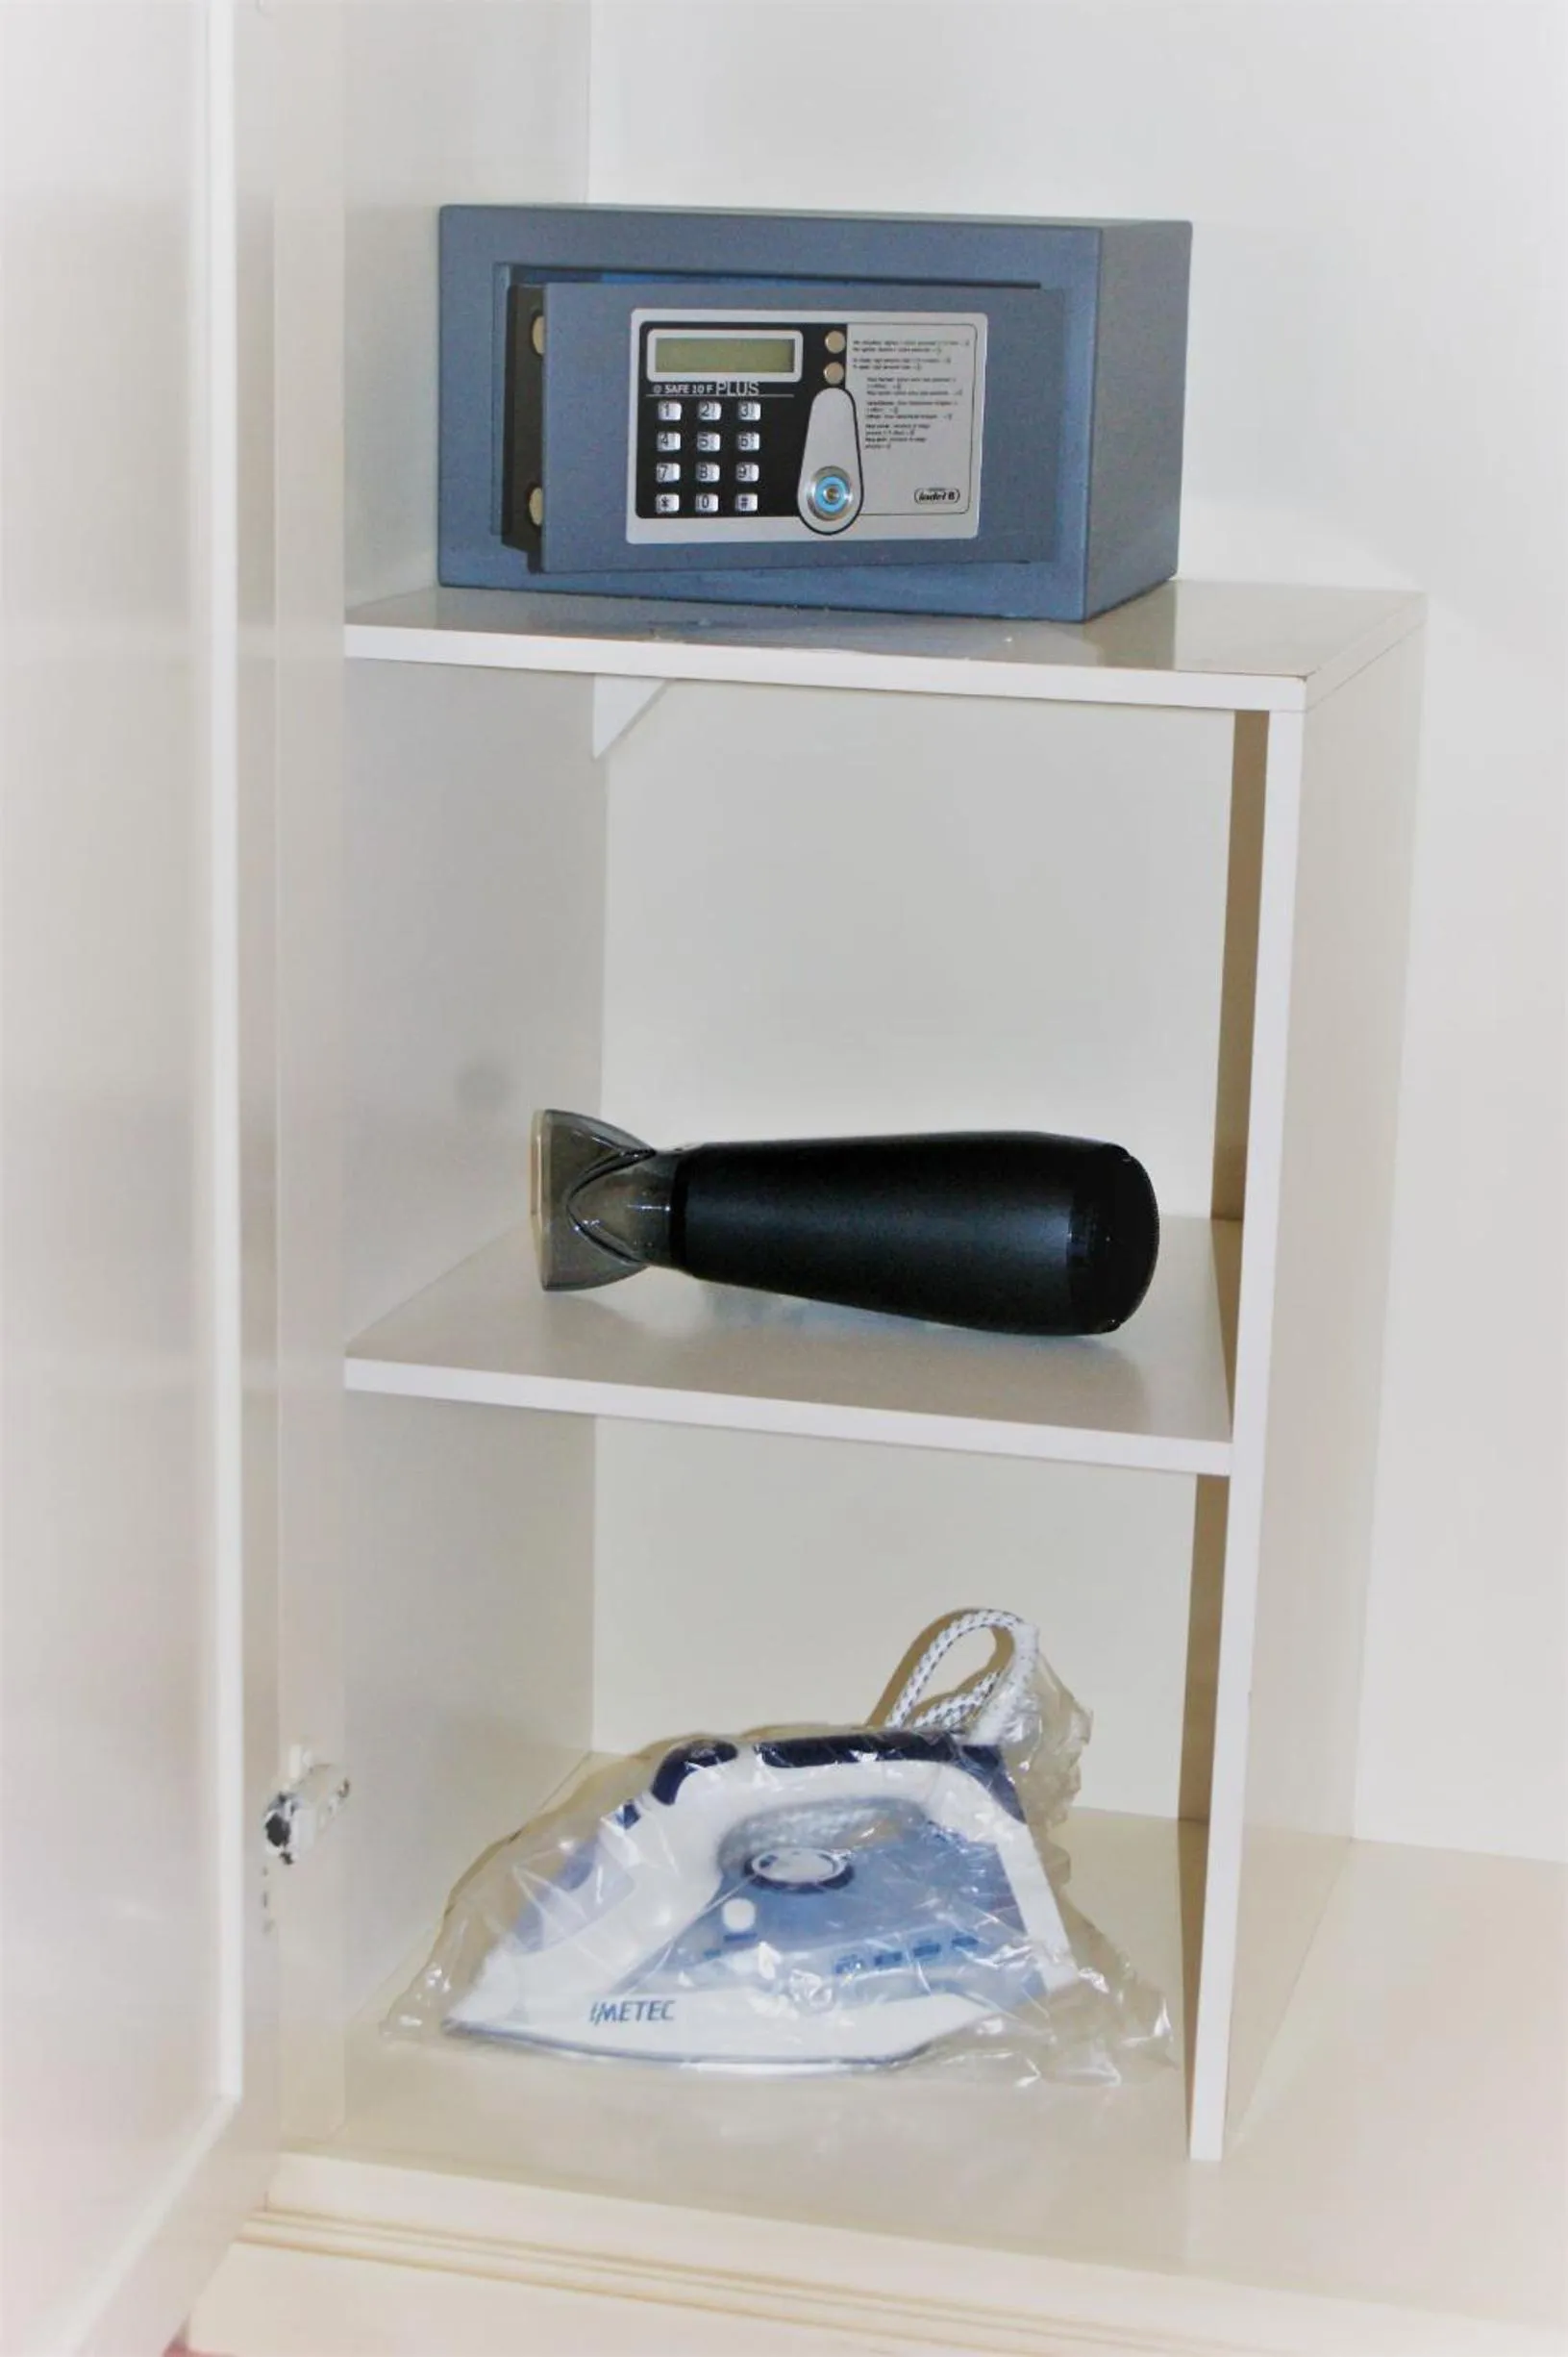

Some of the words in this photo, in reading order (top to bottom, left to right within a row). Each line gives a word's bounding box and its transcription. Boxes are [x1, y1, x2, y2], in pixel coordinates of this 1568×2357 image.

[665, 385, 690, 394] SAFE
[692, 385, 705, 394] 10
[715, 381, 759, 396] PLUS
